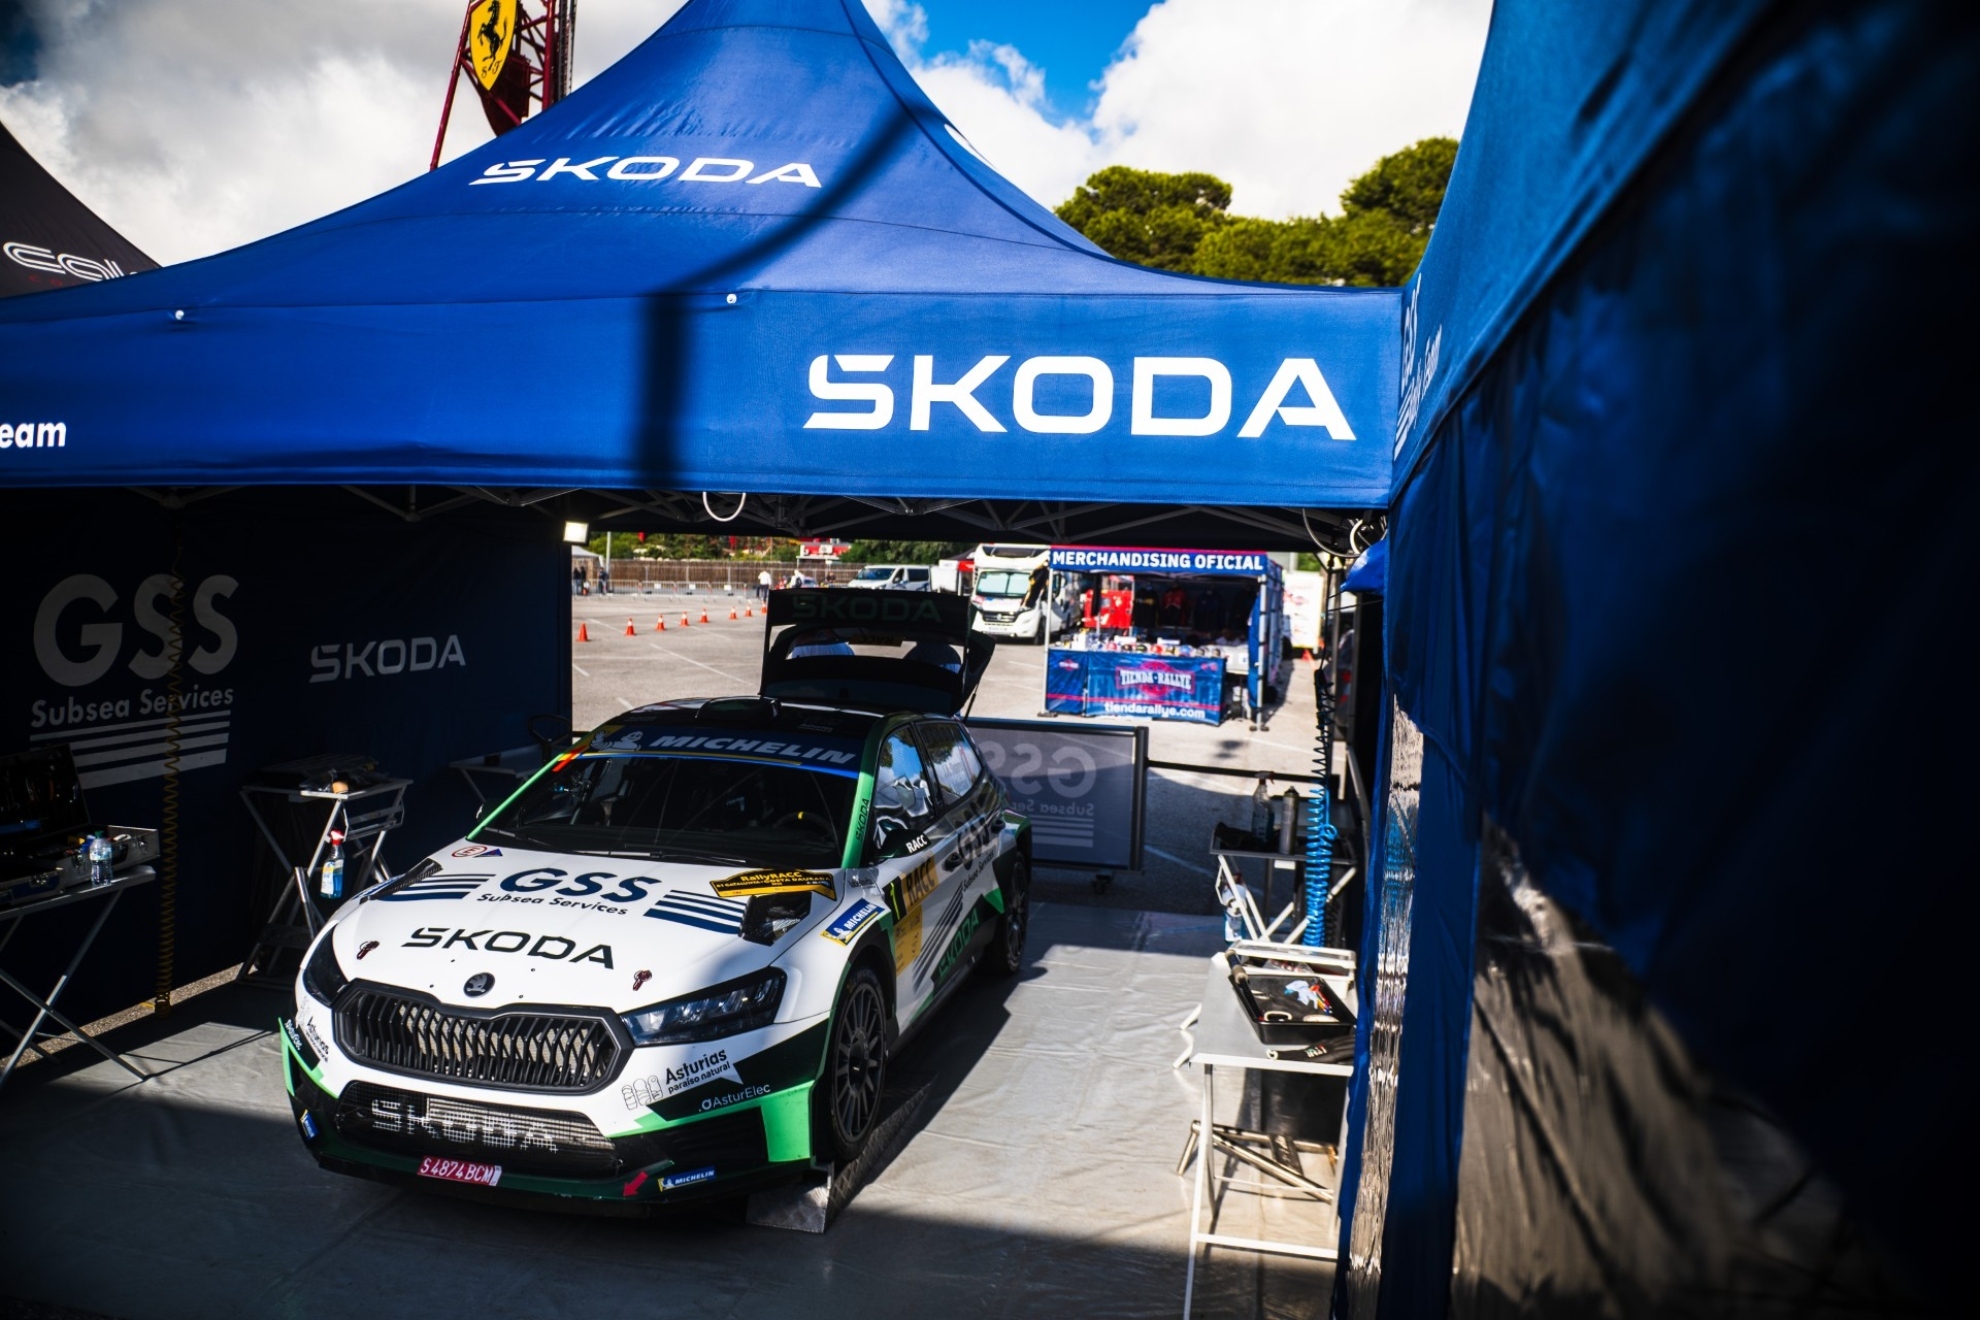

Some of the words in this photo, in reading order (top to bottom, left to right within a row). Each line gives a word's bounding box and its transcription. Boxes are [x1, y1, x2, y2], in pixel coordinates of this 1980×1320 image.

[468, 155, 823, 189] SKODA
[803, 354, 1357, 441] SKODA
[1052, 550, 1191, 569] MERCHANDISING
[1194, 554, 1264, 571] OFICIAL
[792, 594, 943, 623] SKODA
[33, 573, 239, 687] GSS
[308, 634, 467, 684] SKODA
[31, 696, 130, 728] Subsea
[139, 684, 234, 715] Services
[1104, 701, 1206, 719] tiendarallye.com
[649, 735, 857, 765] MICHELIN
[905, 834, 928, 854] RACC
[500, 867, 662, 903] GSS
[905, 858, 936, 906] RACC
[477, 893, 545, 904] Subsea
[549, 896, 629, 916] Services
[844, 903, 878, 930] MICHELIN
[402, 927, 615, 970] SKODA
[665, 1049, 728, 1085] Asturias
[700, 1061, 732, 1081] natural
[675, 1169, 715, 1185] MICHELIN
